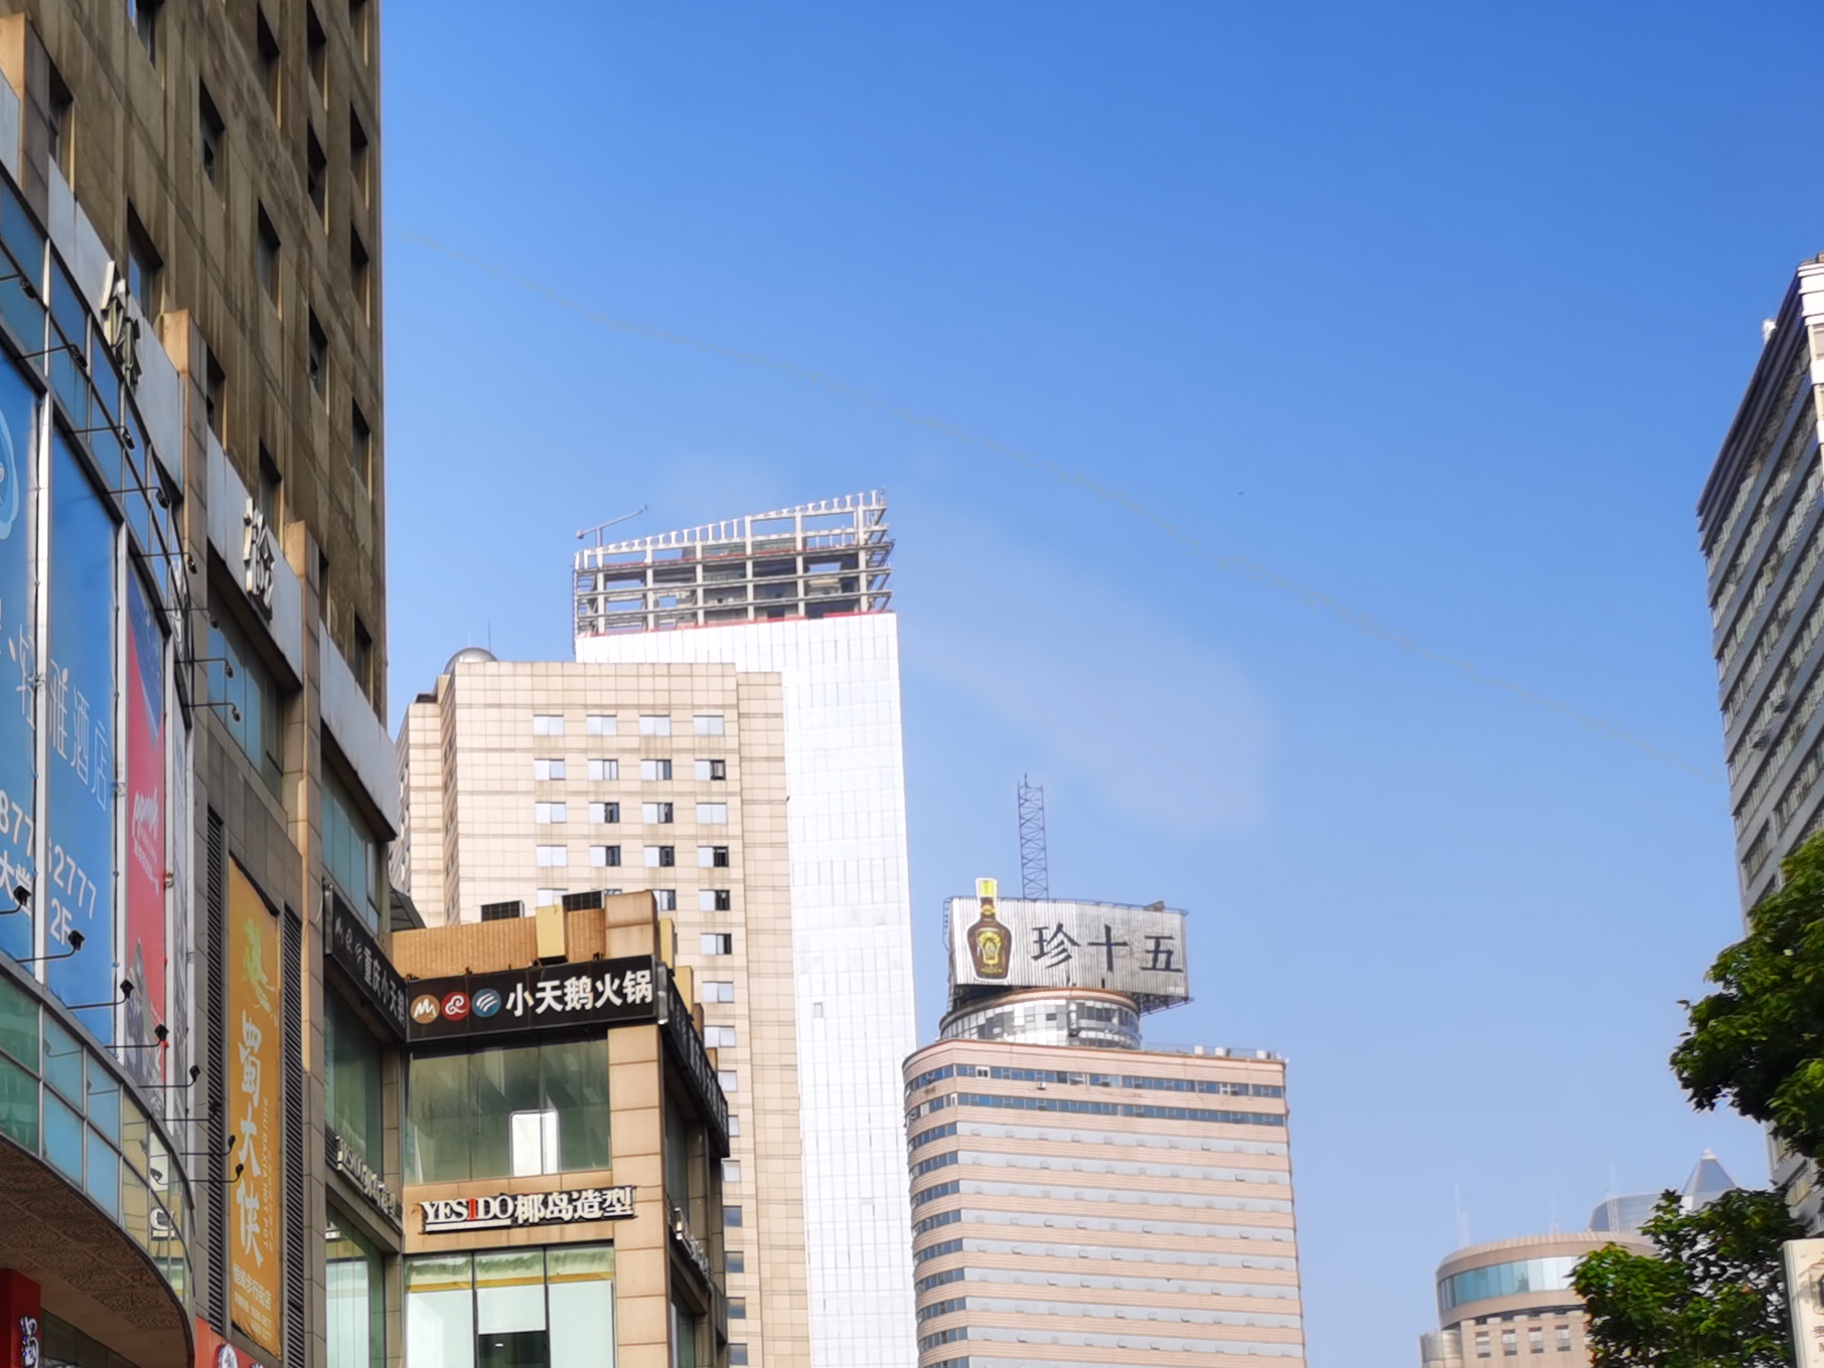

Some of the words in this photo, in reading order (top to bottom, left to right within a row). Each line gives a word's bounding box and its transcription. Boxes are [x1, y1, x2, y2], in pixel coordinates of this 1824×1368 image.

[1030, 921, 1184, 974] 珍十五
[506, 968, 653, 1018] 小天鹅火锅
[420, 1194, 514, 1226] YESIDO
[514, 1186, 634, 1225] 椰岛造型
